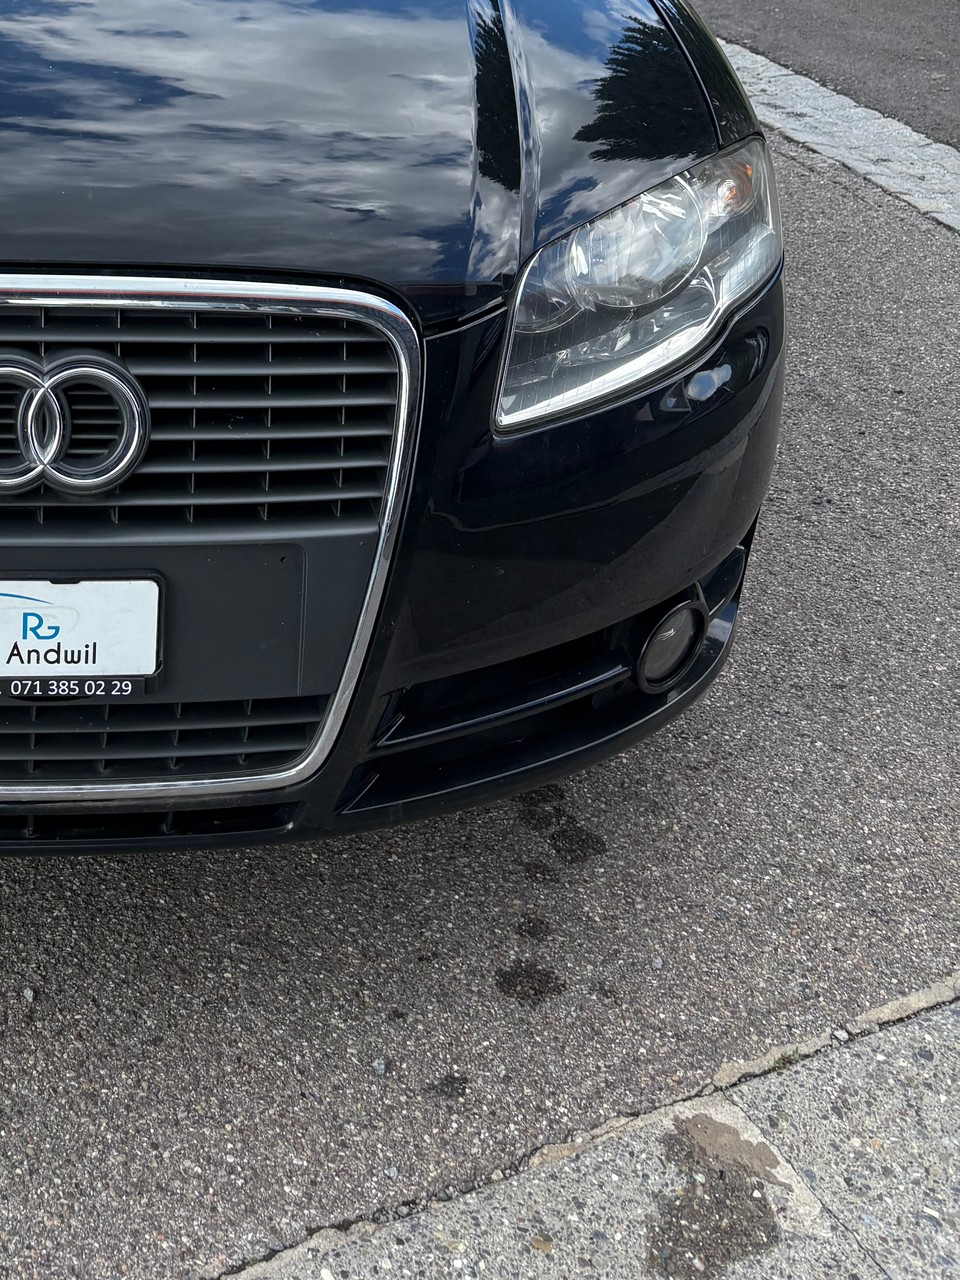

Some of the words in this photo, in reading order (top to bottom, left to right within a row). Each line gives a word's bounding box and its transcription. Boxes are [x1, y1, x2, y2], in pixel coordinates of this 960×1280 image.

[6, 641, 97, 665] Andwil
[10, 680, 43, 695] 071
[48, 680, 79, 695] 385
[84, 680, 106, 695] 02
[111, 680, 132, 695] 29
